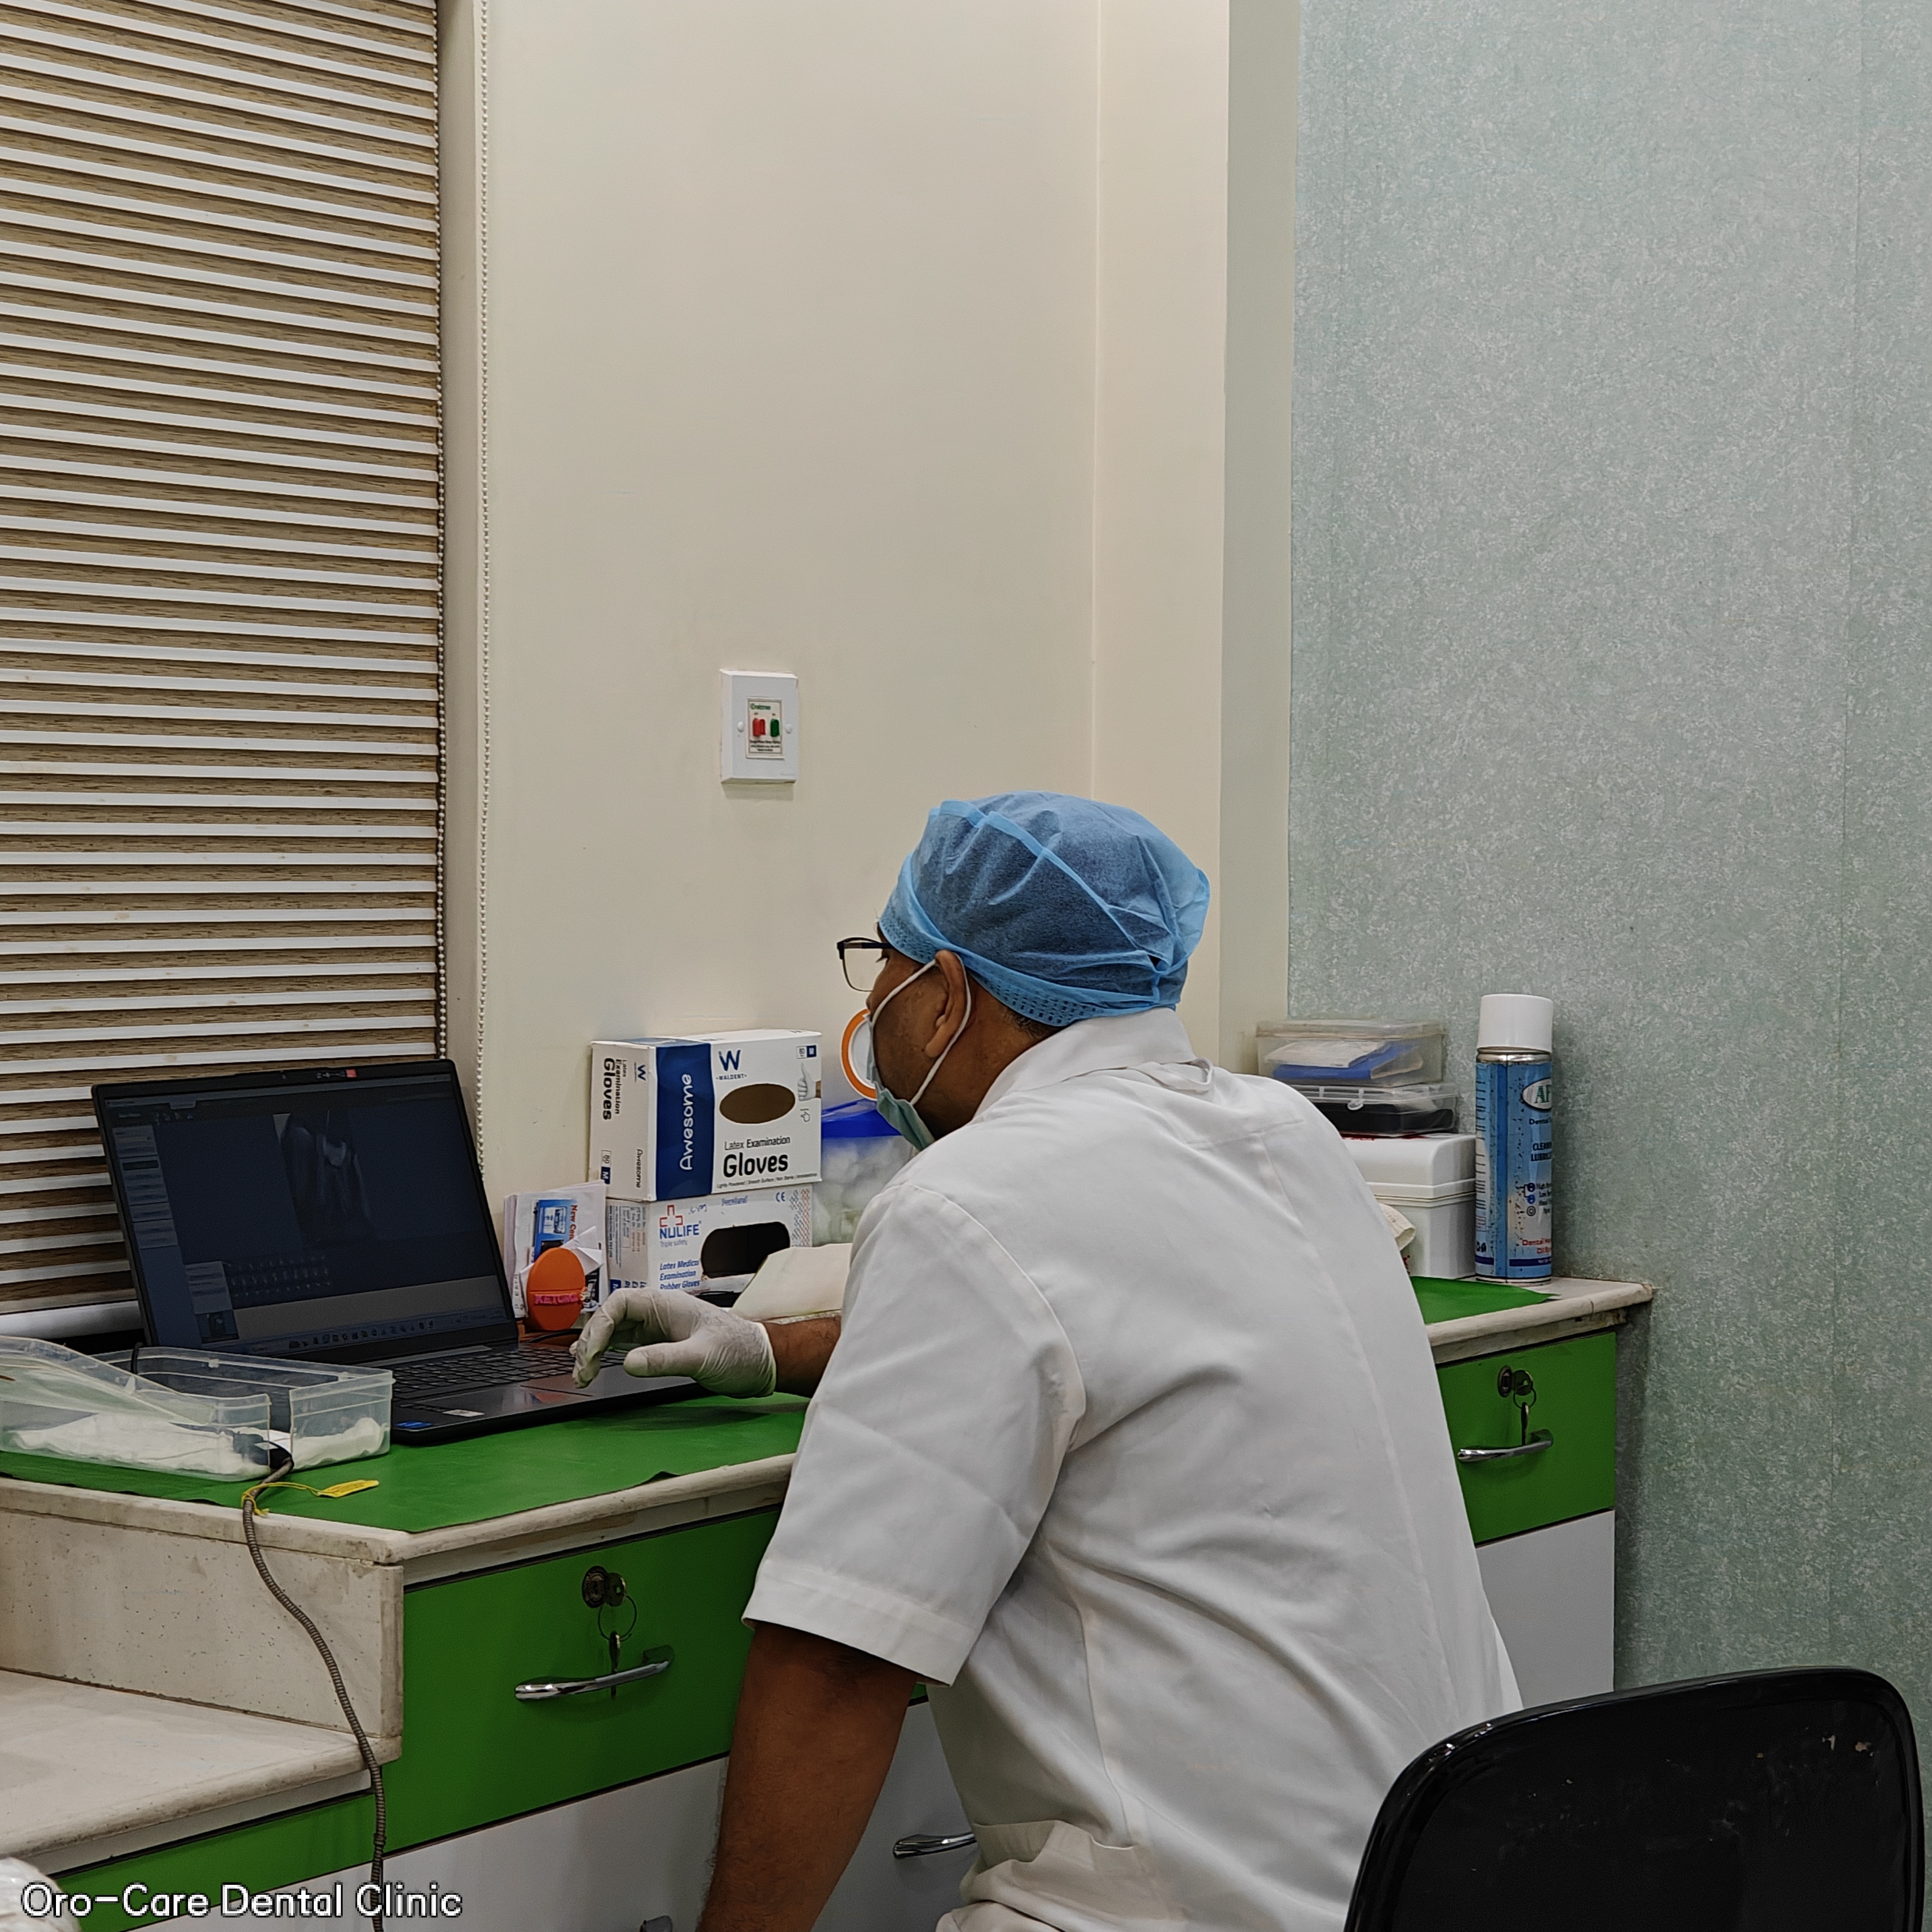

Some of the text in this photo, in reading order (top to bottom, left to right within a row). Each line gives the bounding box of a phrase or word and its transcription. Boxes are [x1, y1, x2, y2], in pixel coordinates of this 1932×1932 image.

[718, 1049, 741, 1072] W
[603, 1057, 615, 1121] Gloves
[679, 1072, 694, 1171] Awesome
[724, 1136, 791, 1151] Latex Examination
[635, 1148, 643, 1188] Awesome
[723, 1152, 789, 1178] Gloves
[775, 1191, 786, 1203] CE
[659, 1223, 700, 1240] NULIFE
[660, 1269, 696, 1281] Examination
[682, 1279, 700, 1289] Gloves
